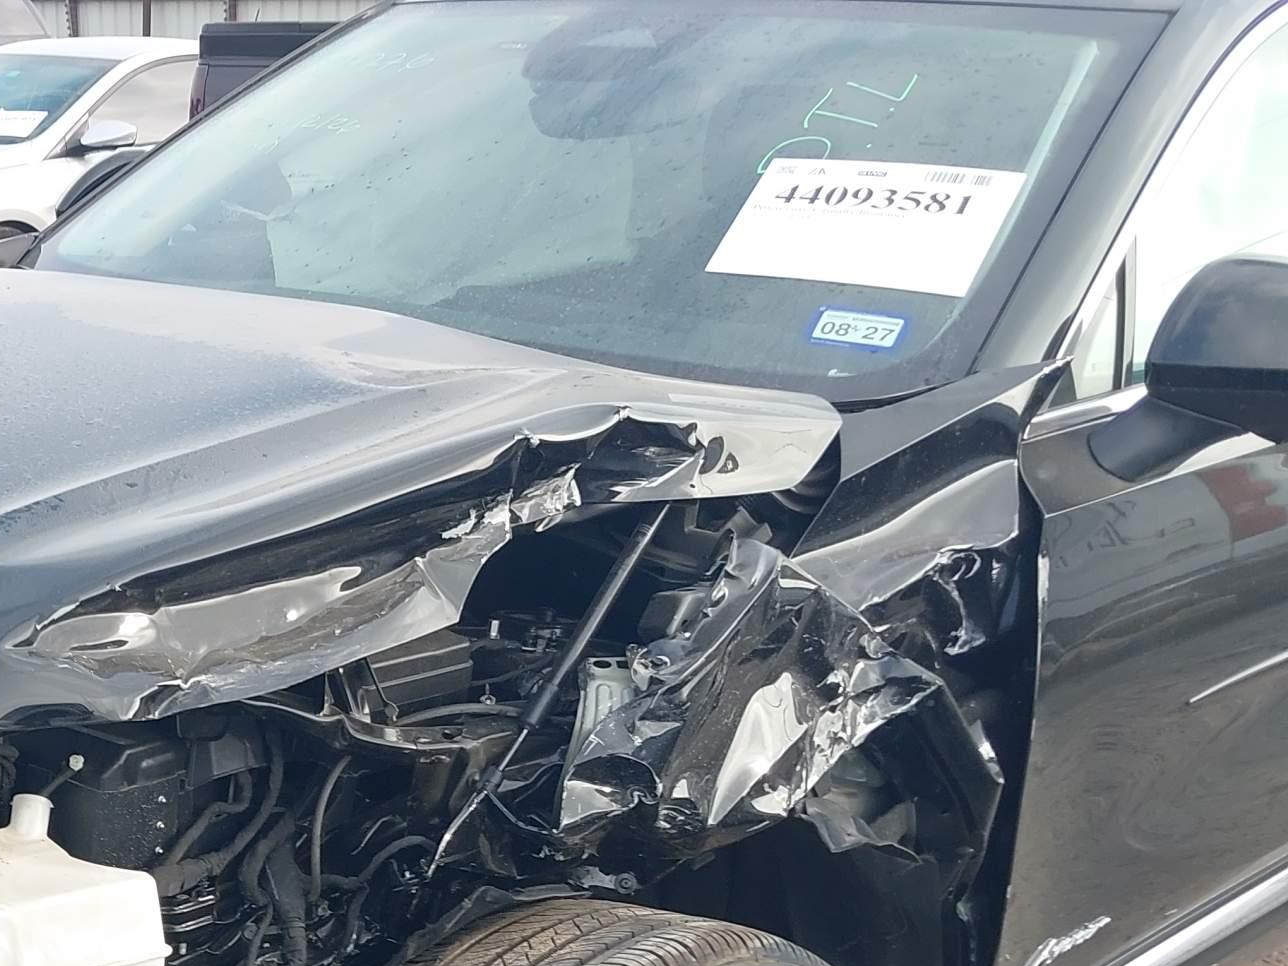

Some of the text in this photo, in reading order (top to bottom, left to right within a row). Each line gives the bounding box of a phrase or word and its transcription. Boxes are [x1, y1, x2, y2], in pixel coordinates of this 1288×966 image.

[775, 184, 973, 215] 44093581
[820, 321, 896, 342] 08 27
